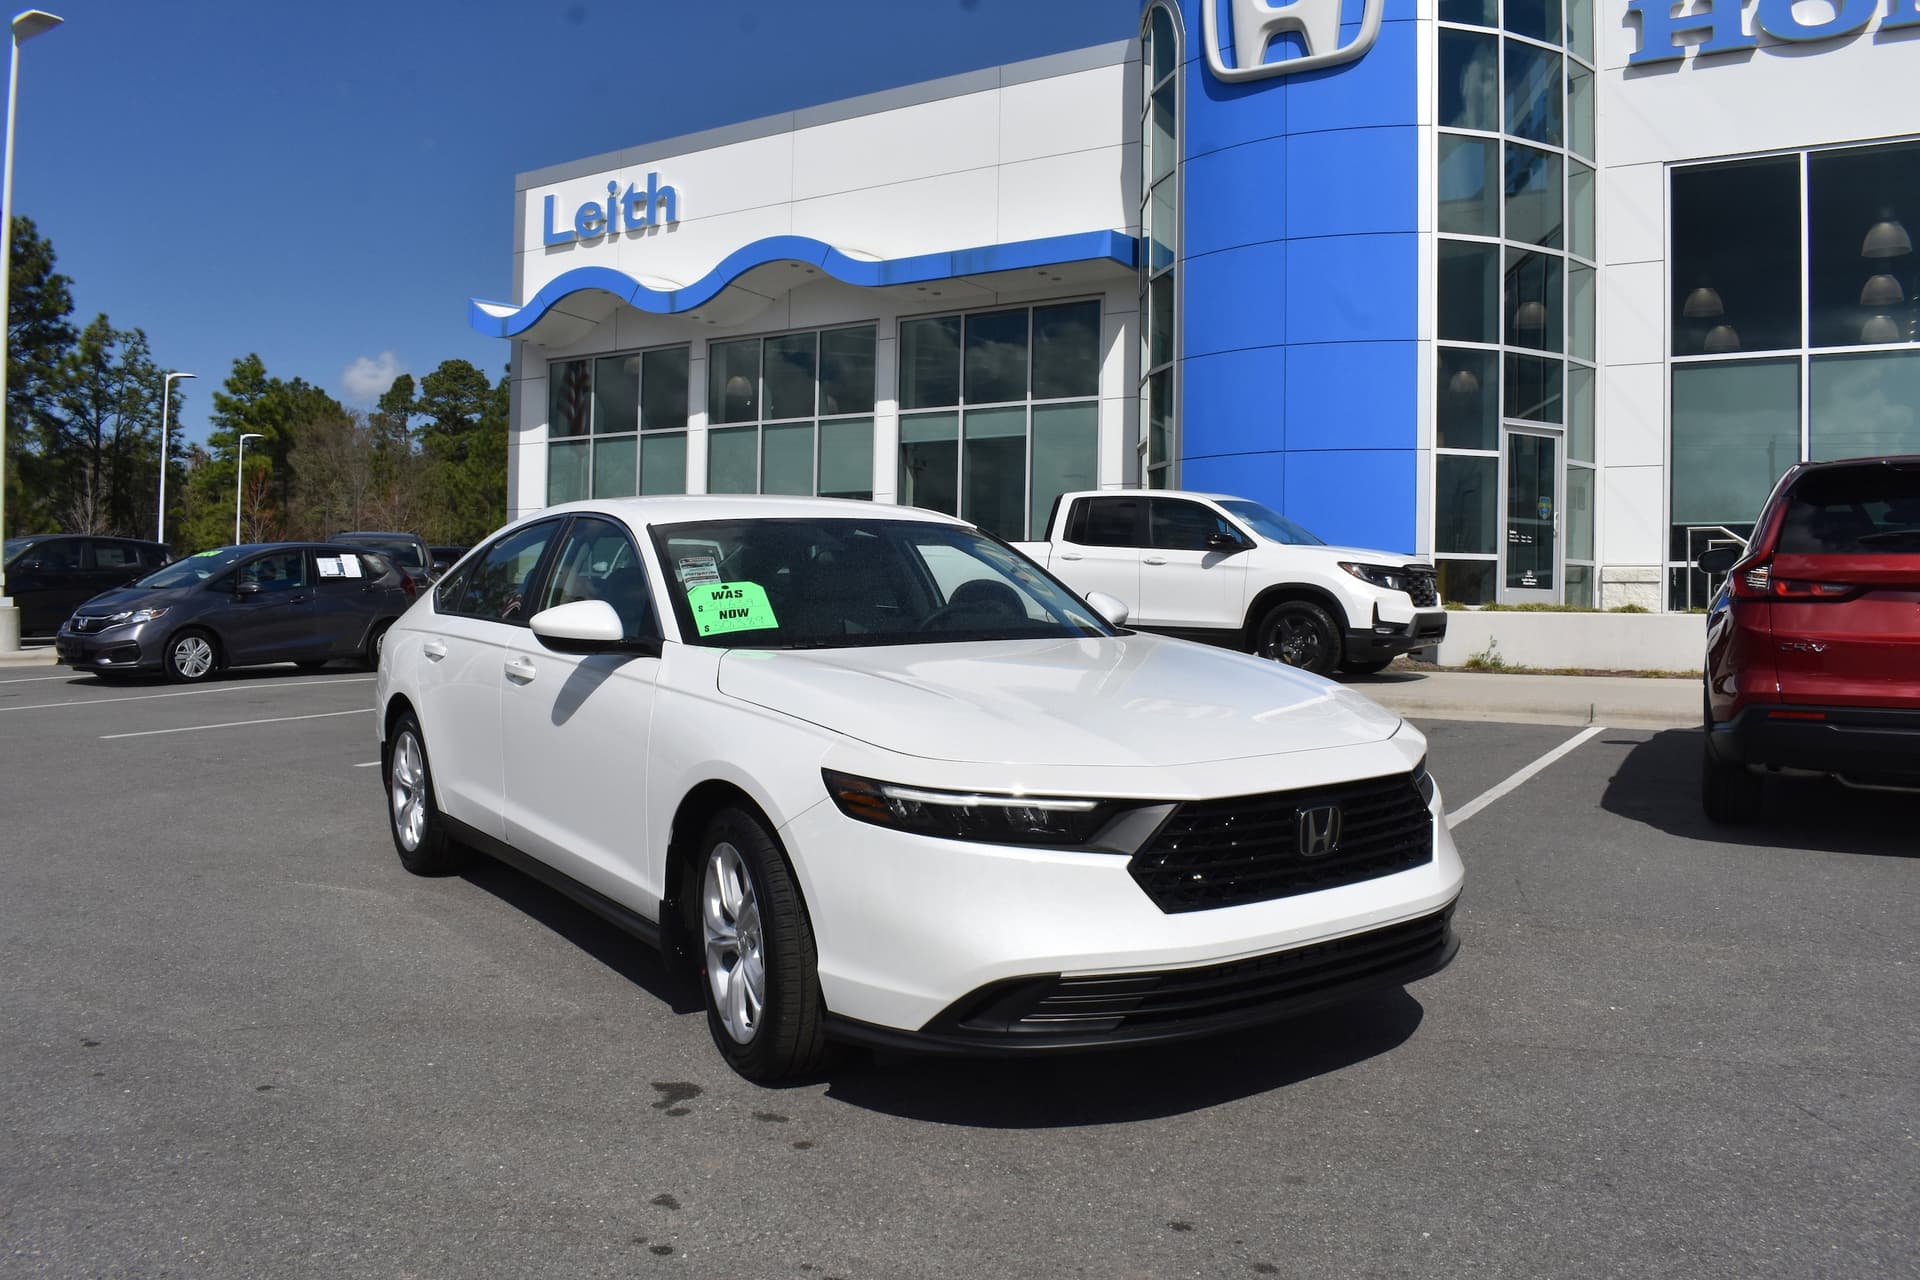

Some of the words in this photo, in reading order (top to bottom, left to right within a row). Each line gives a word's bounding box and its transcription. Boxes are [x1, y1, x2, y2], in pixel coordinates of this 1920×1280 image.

[543, 171, 677, 246] Leith
[711, 589, 743, 600] WAS
[719, 608, 749, 619] NOW
